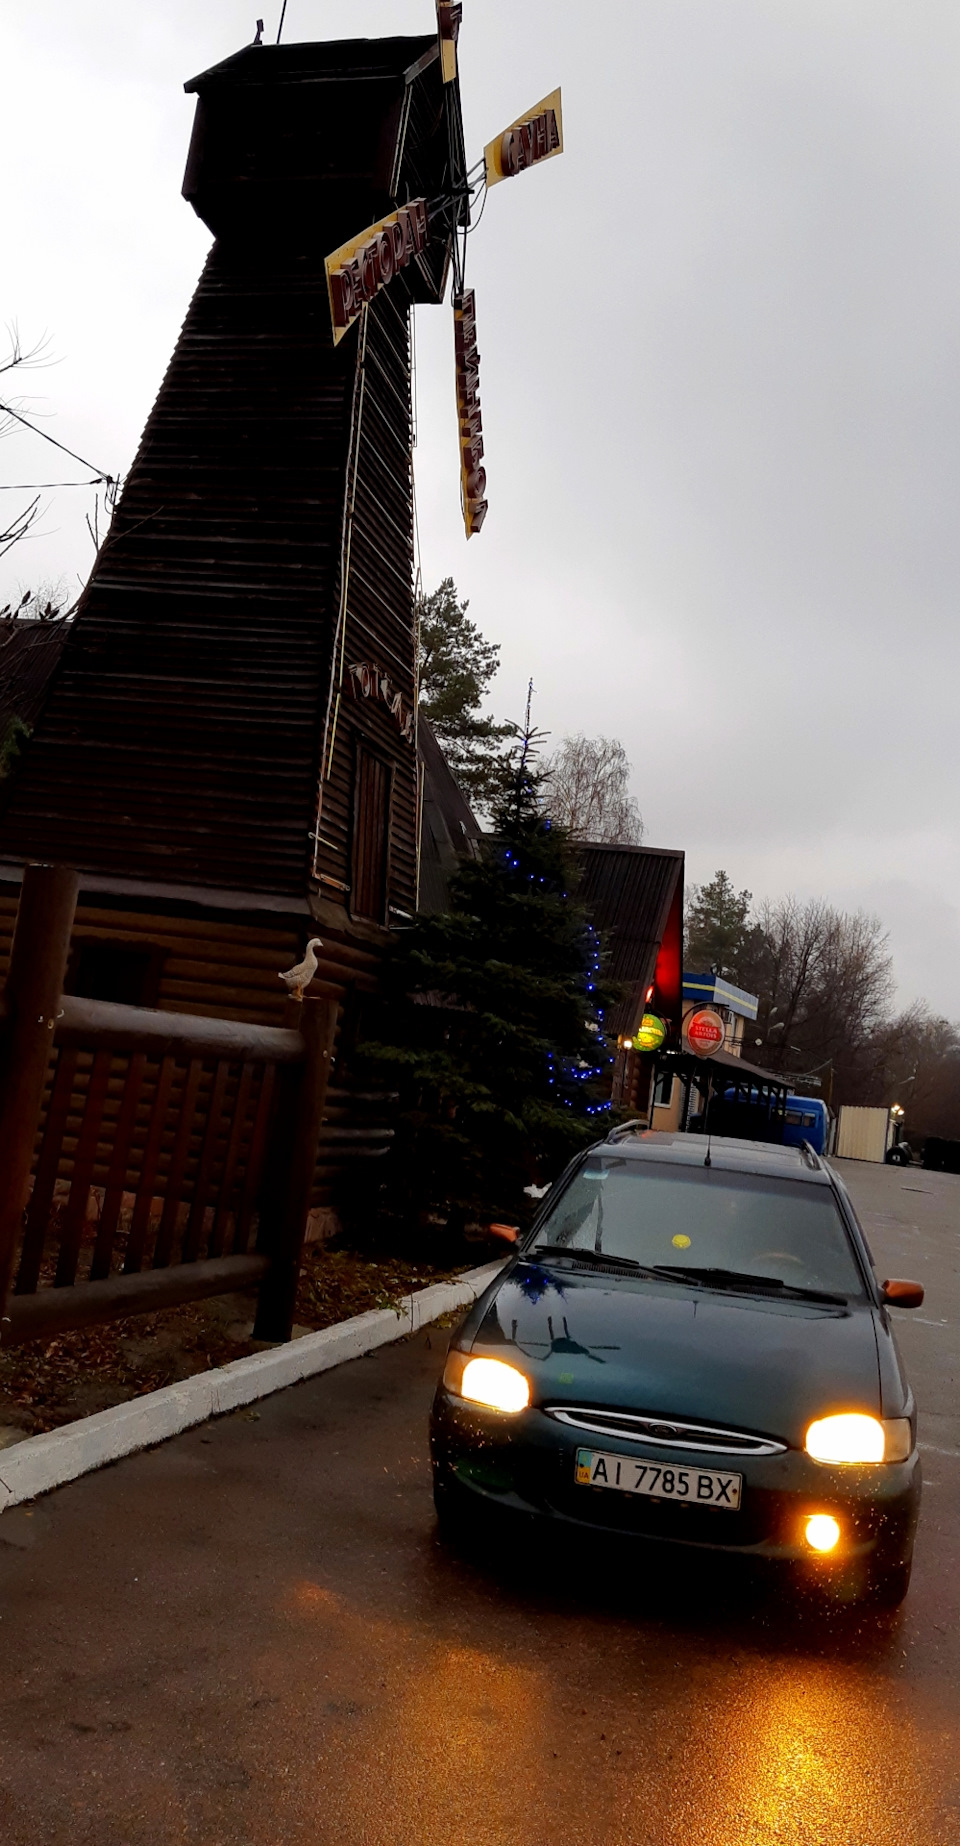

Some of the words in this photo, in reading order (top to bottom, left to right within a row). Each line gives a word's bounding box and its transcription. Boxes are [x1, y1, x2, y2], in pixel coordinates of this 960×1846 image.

[500, 109, 560, 177] САУНА
[330, 197, 428, 328] РЕСТОРАН
[695, 1025, 718, 1034] STELLA
[634, 1464, 690, 1496] 7785
[697, 1475, 733, 1503] BX
